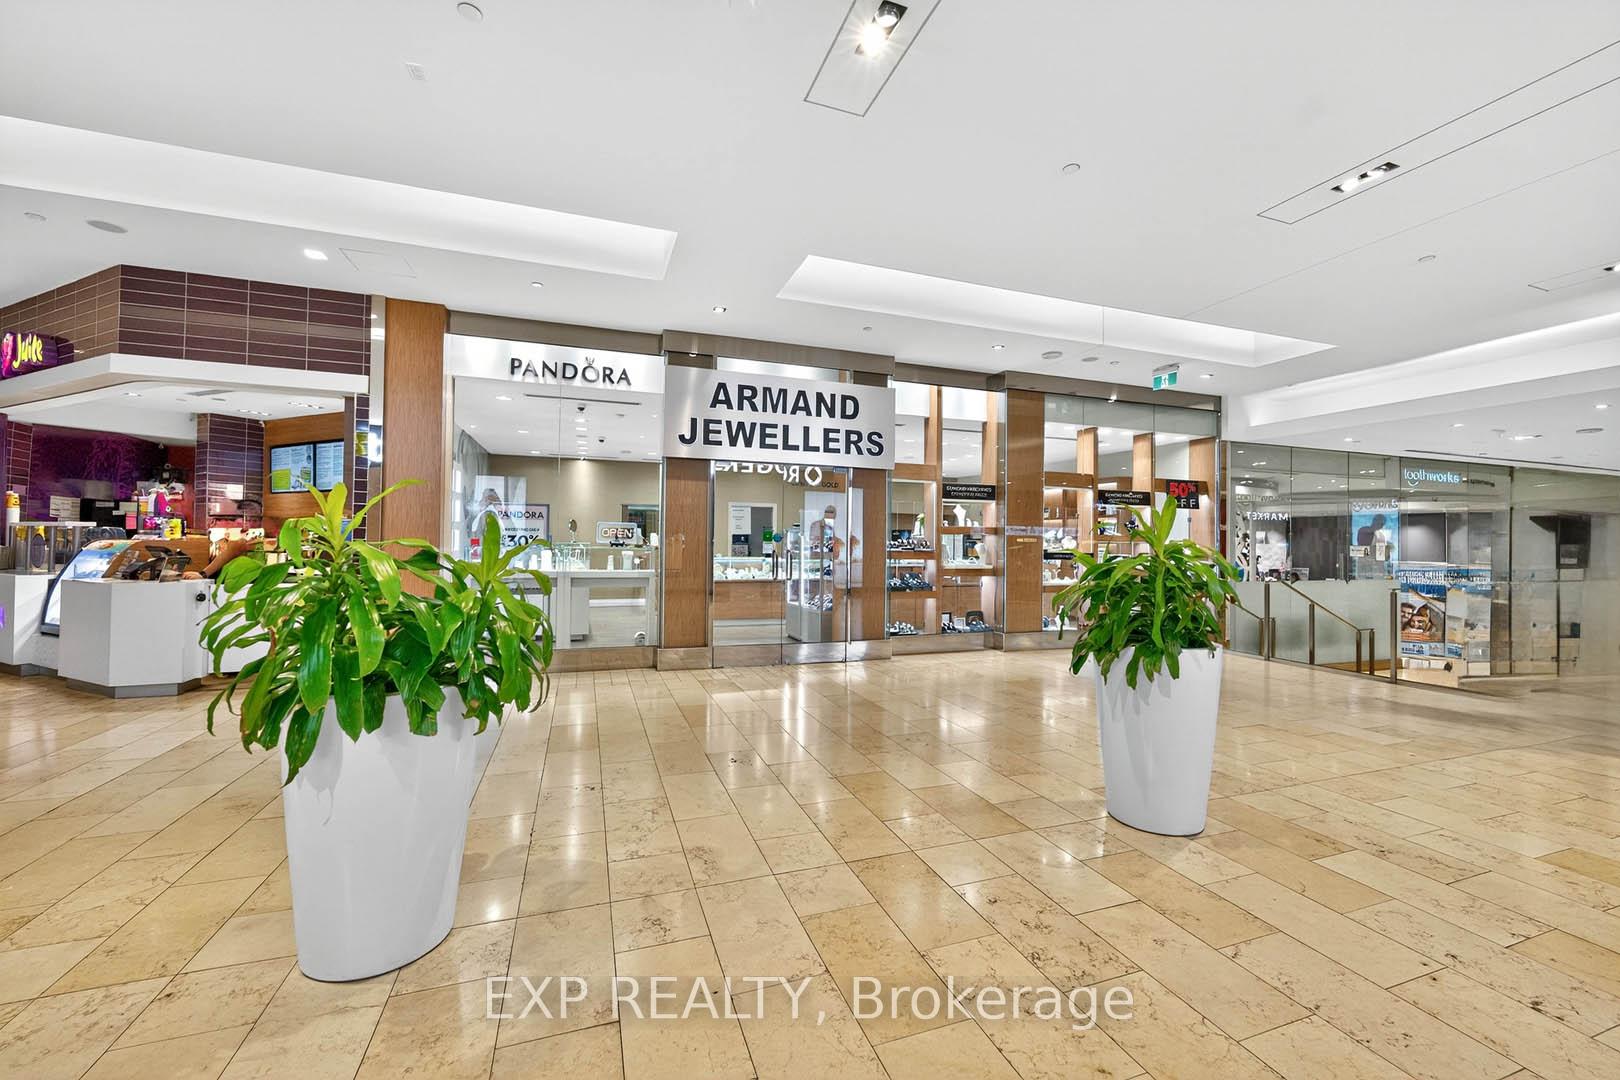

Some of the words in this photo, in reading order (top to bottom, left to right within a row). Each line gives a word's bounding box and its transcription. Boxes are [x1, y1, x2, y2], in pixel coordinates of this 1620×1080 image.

[12, 333, 43, 369] Juice
[510, 356, 632, 386] PANDORA
[709, 382, 860, 420] ARMAND
[678, 417, 885, 457] JEWELLERS
[498, 511, 545, 519] PANDORA
[601, 527, 633, 538] OPEN
